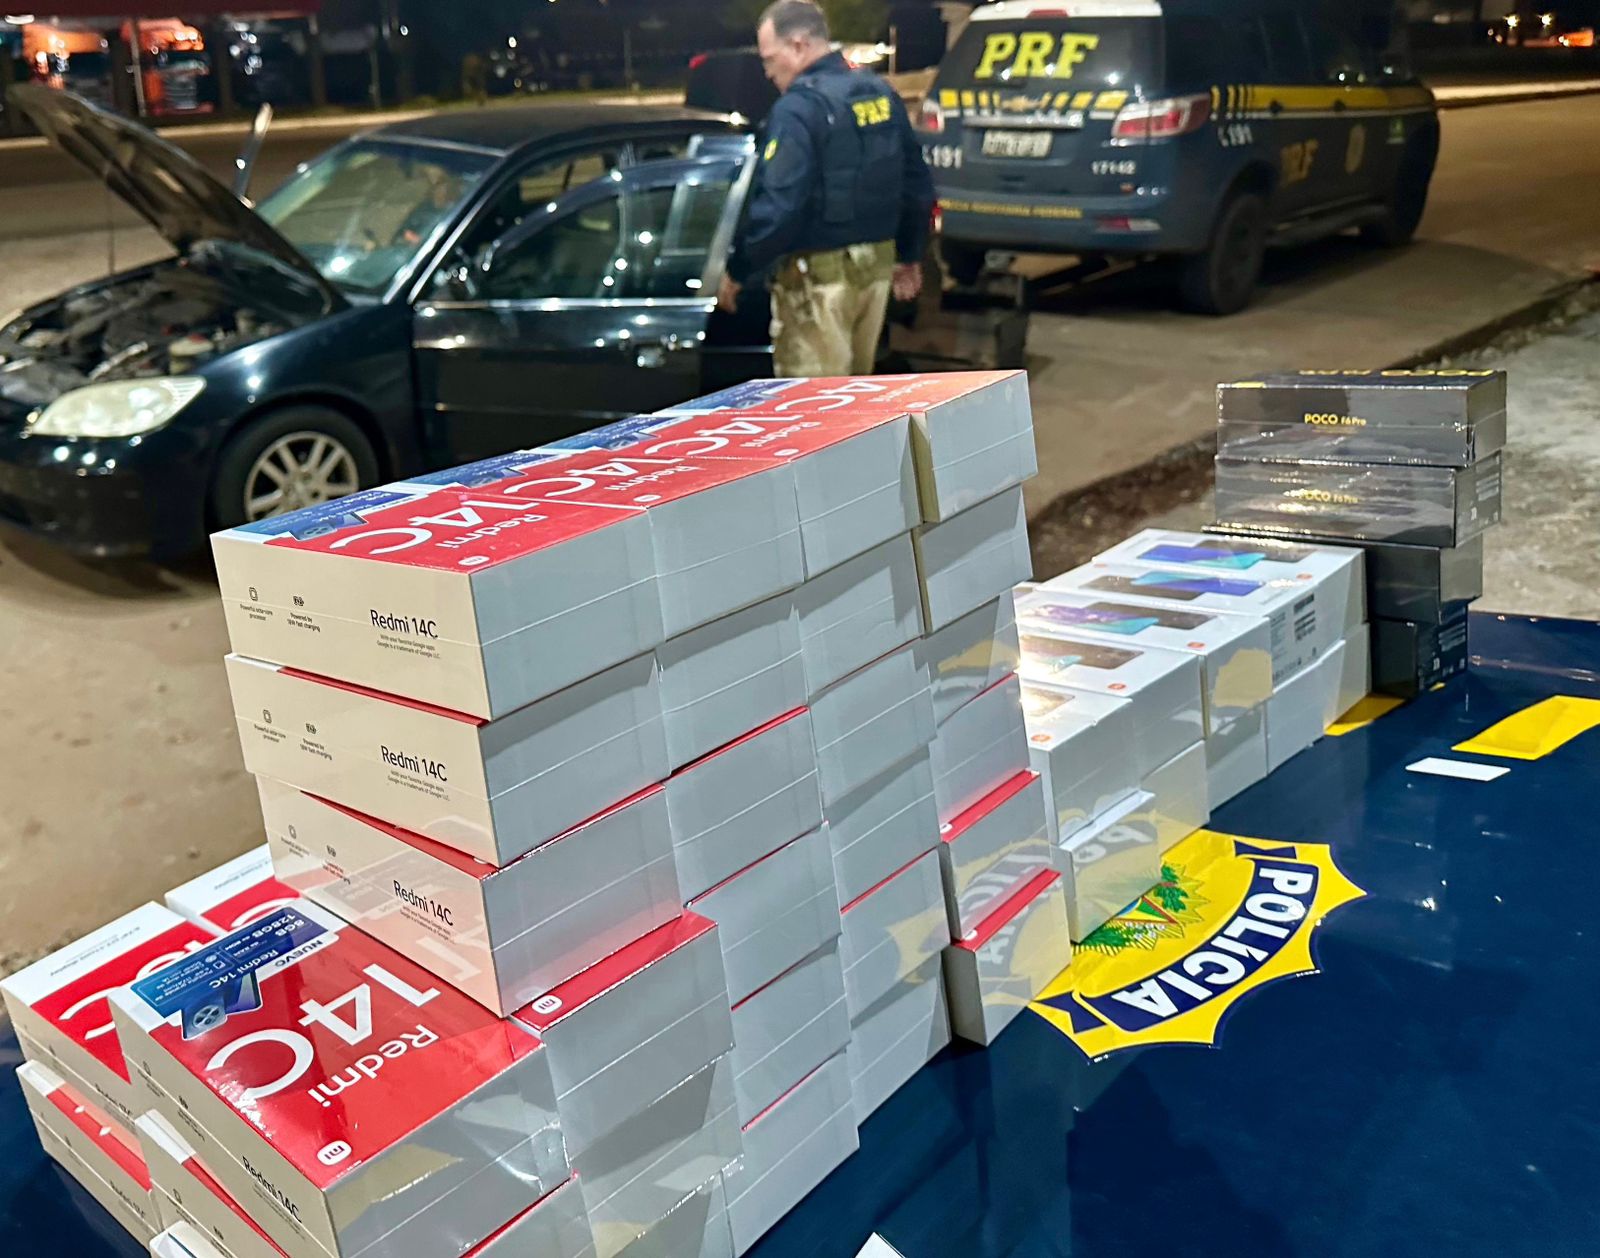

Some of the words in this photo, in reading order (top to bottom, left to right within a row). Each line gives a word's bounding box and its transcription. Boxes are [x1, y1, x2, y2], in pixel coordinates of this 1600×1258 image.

[974, 31, 1100, 79] PRF
[931, 145, 963, 169] 191
[644, 415, 803, 456] 14C
[740, 421, 822, 448] Redmi
[1304, 413, 1339, 425] POCO
[504, 457, 685, 498] 14C
[604, 465, 698, 491] Redmi
[329, 499, 540, 555] 14C
[436, 513, 548, 550] Redmi
[370, 608, 410, 634] Redmi
[411, 617, 439, 640] 14C
[381, 745, 419, 773] Redmi
[421, 758, 447, 782] 14C
[393, 879, 428, 912] Redmi
[430, 900, 454, 927] 14C
[252, 913, 296, 938] 128GB
[275, 919, 305, 937] 8GB
[1111, 867, 1314, 1018] POLÍCIA
[236, 949, 279, 976] Redmi
[274, 940, 324, 967] NUEVO
[209, 971, 238, 989] 14C
[205, 963, 441, 1104] 14C
[307, 1024, 439, 1107] Redmi
[242, 1156, 277, 1198] Redmi
[276, 1191, 302, 1224] 14C
